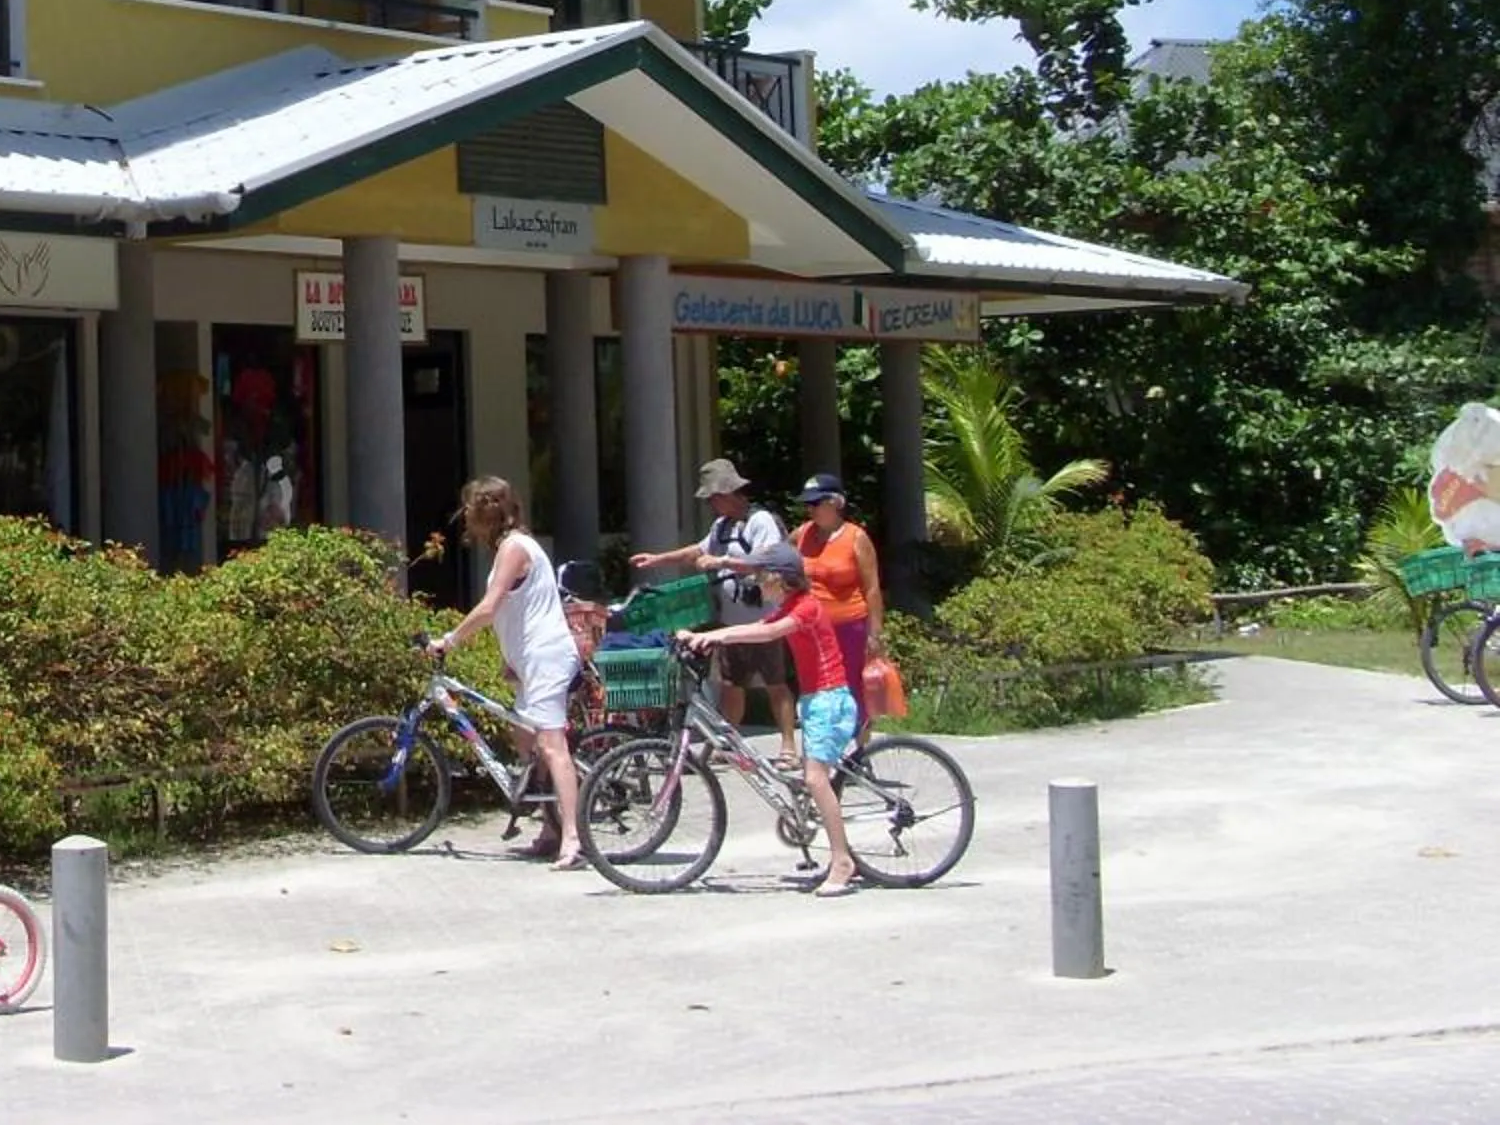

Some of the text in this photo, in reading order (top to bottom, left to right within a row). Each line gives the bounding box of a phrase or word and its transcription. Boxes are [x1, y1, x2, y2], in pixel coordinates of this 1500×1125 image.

[794, 298, 843, 330] LUCA
[879, 299, 953, 332] ICE CREAM
